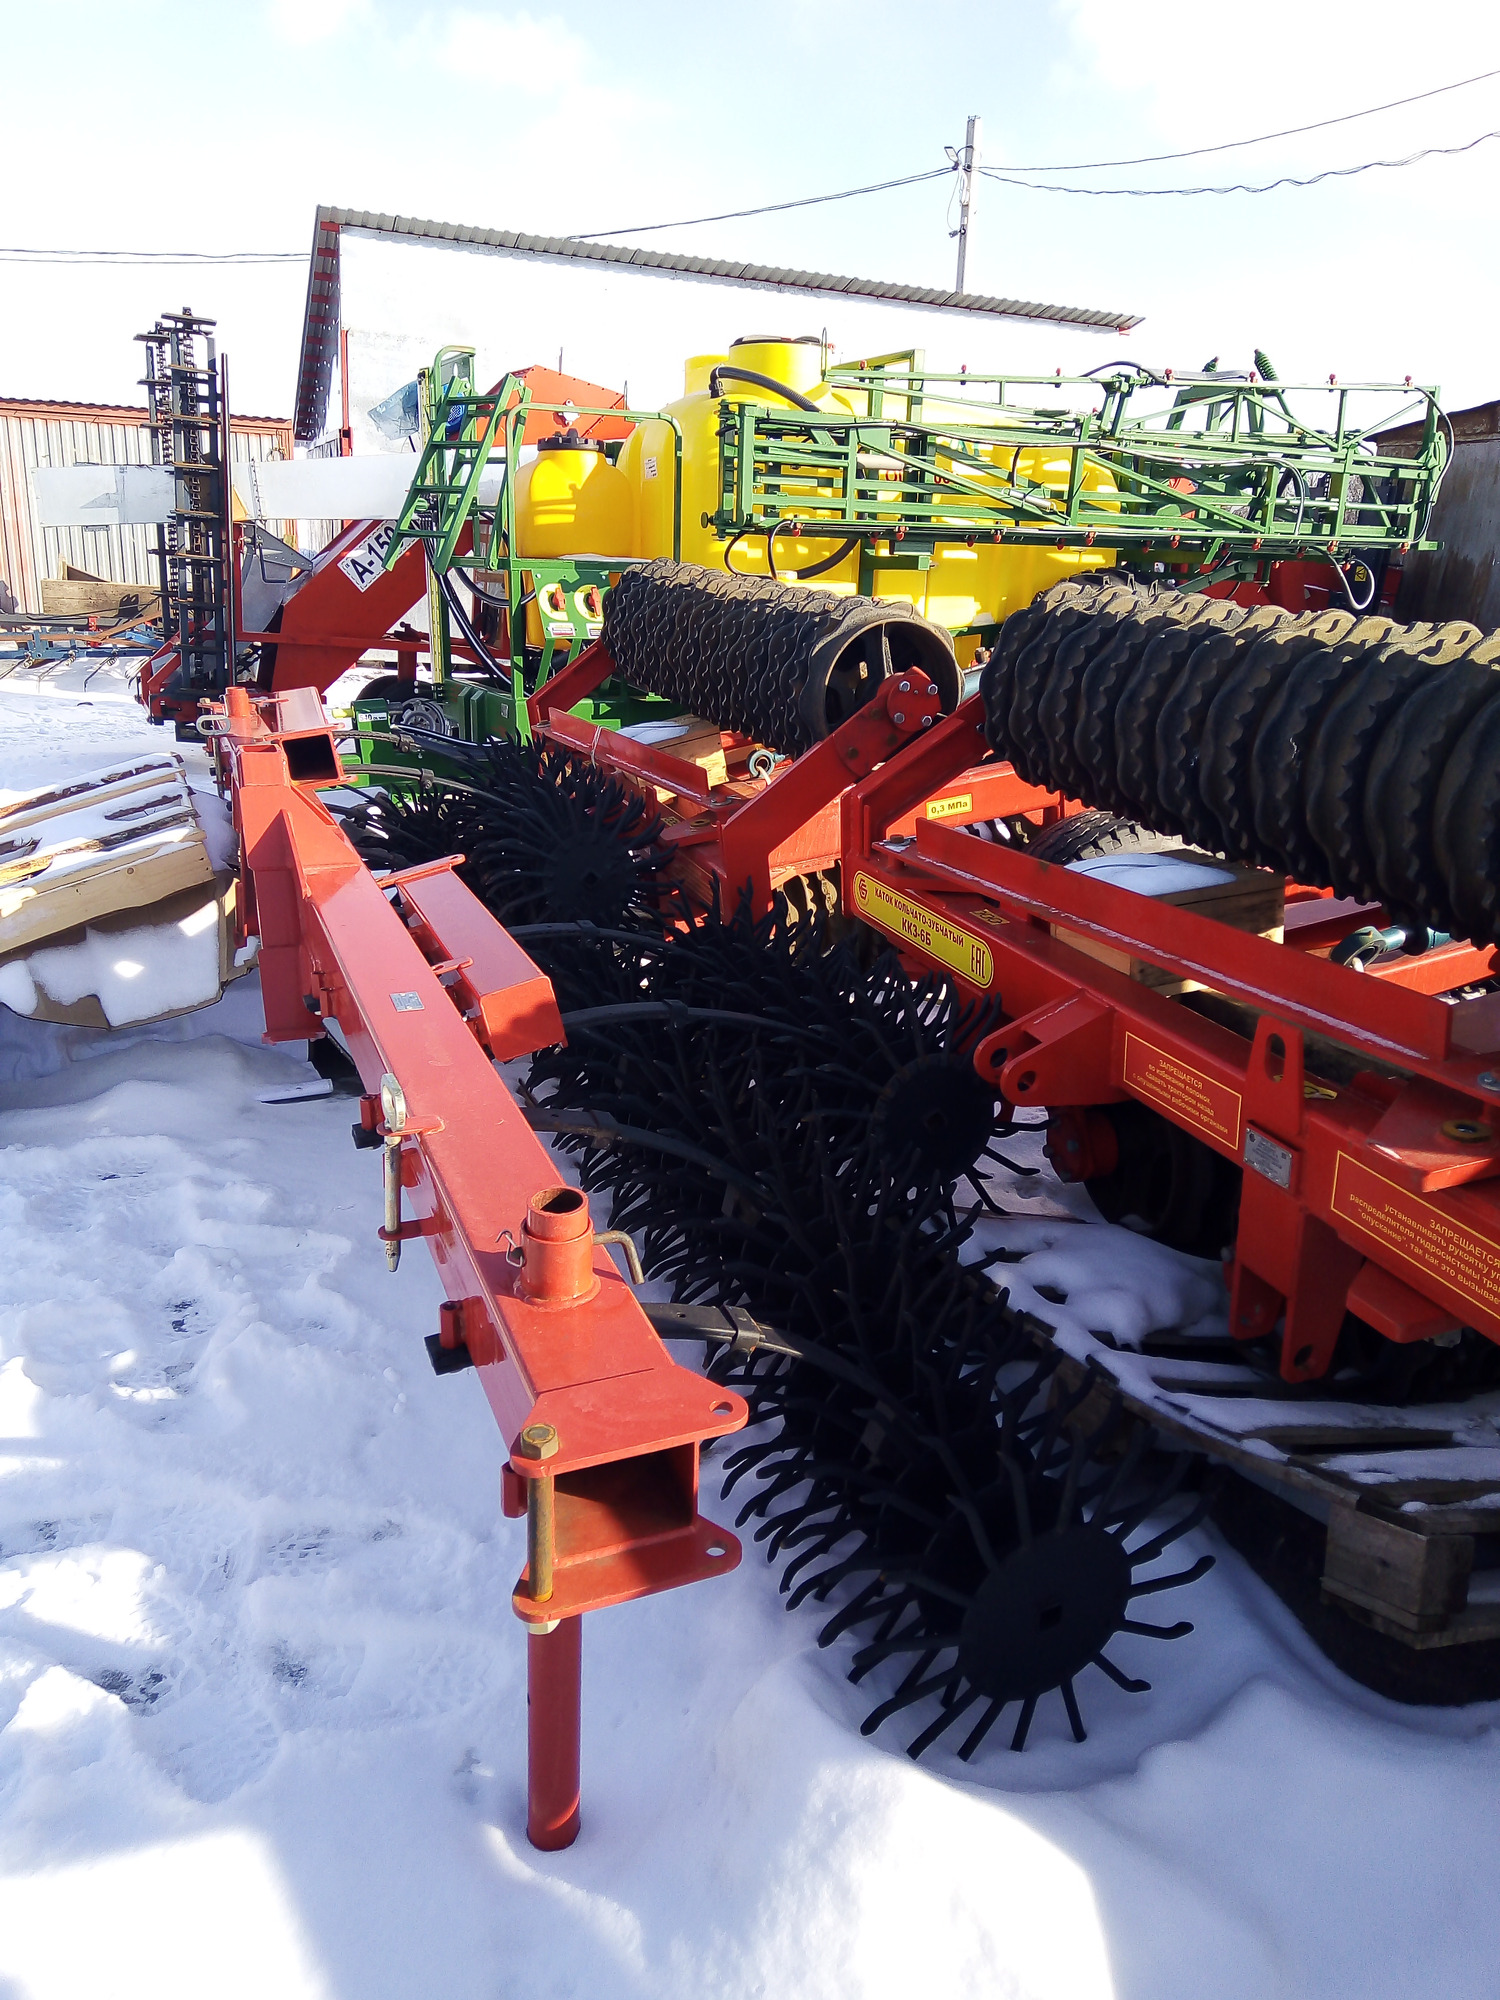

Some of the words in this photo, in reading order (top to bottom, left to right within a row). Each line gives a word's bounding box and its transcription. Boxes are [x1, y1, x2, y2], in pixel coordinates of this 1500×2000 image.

[931, 804, 945, 814] 0,3
[947, 801, 968, 811] МПа
[874, 886, 894, 905] КАТОК
[893, 898, 964, 948] КОЛЬЧАТО-ЗУБЧАТЫЙ
[1159, 1059, 1203, 1090] ЗАПРЕЩАЕТСЯ
[1349, 1193, 1415, 1239] распределителя
[1416, 1235, 1480, 1280] гидросистемы
[1384, 1203, 1447, 1247] устанавливать
[1448, 1243, 1489, 1274] рукоятку
[1429, 1219, 1500, 1269] ЗАПРЕЩАЕТСЯ
[1409, 1242, 1424, 1257] так
[1424, 1252, 1439, 1267] как
[1440, 1262, 1456, 1277] это
[1457, 1273, 1500, 1305] вызывае
